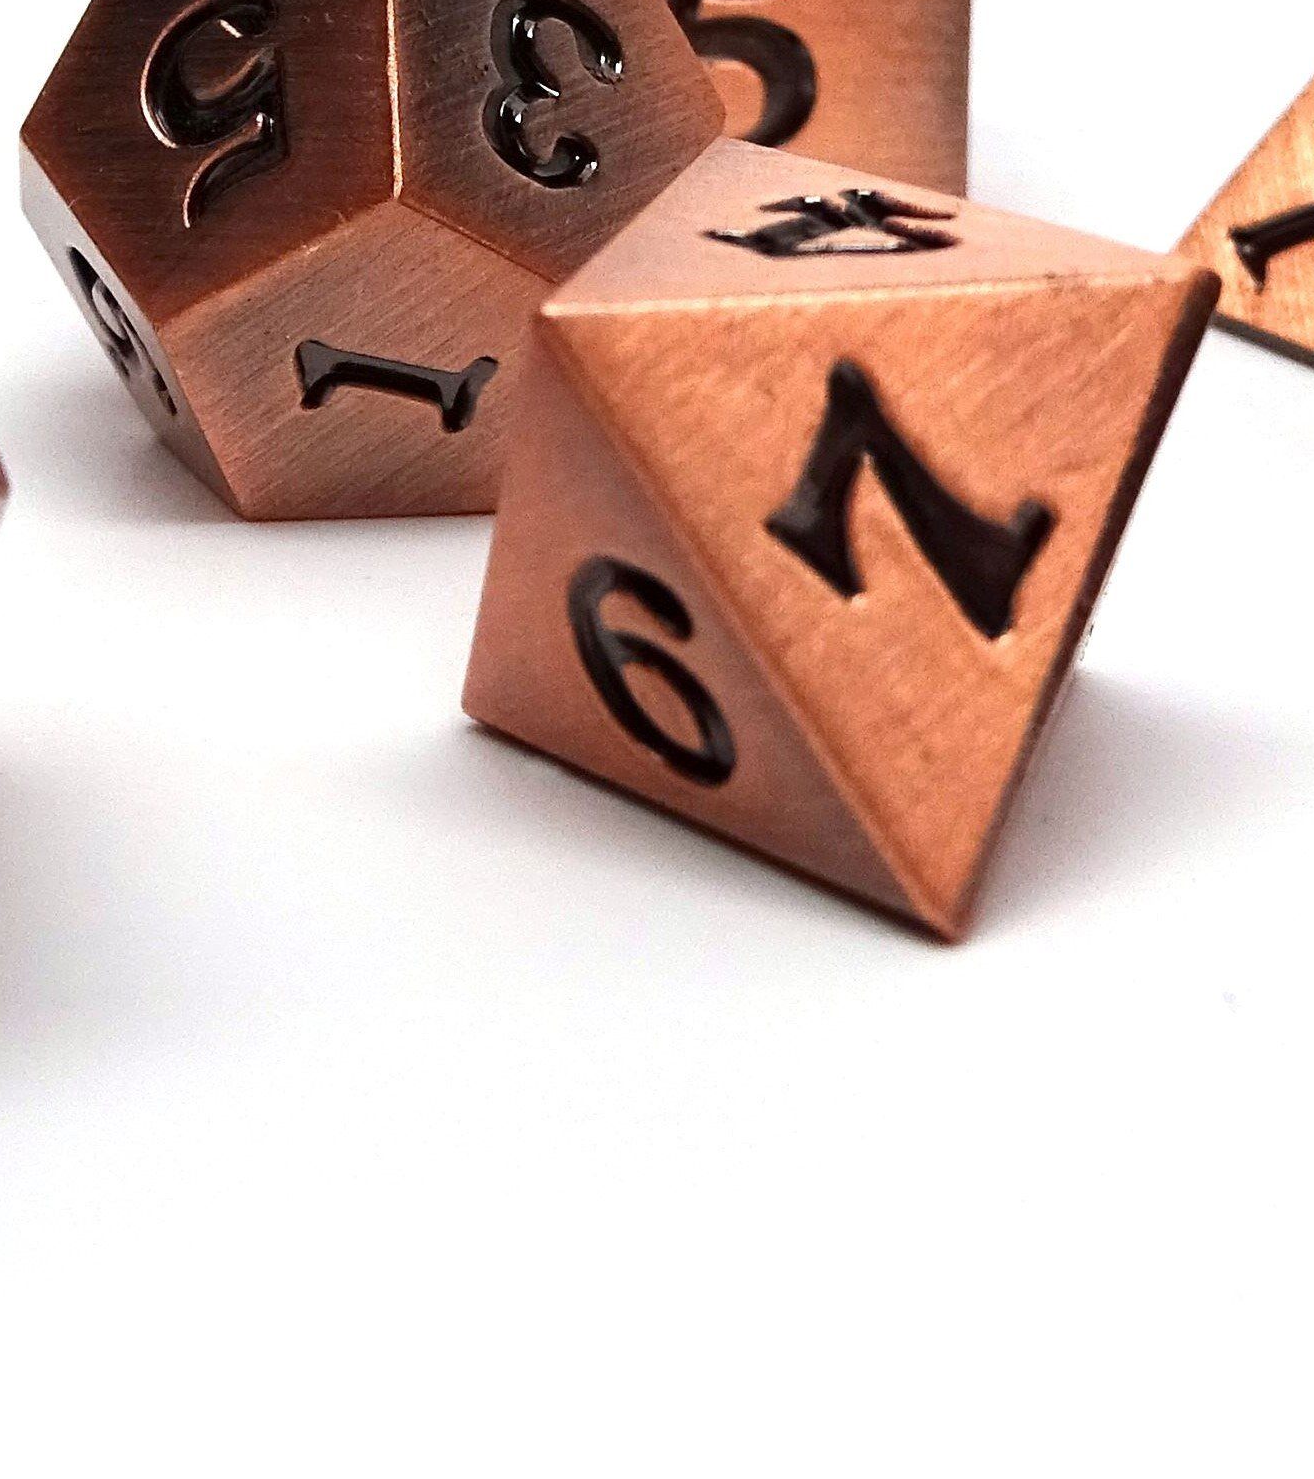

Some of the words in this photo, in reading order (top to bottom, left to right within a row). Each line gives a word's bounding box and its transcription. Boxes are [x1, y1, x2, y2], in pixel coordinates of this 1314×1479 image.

[293, 340, 498, 433] 1
[764, 356, 1060, 641] 7
[568, 554, 737, 786] 6
